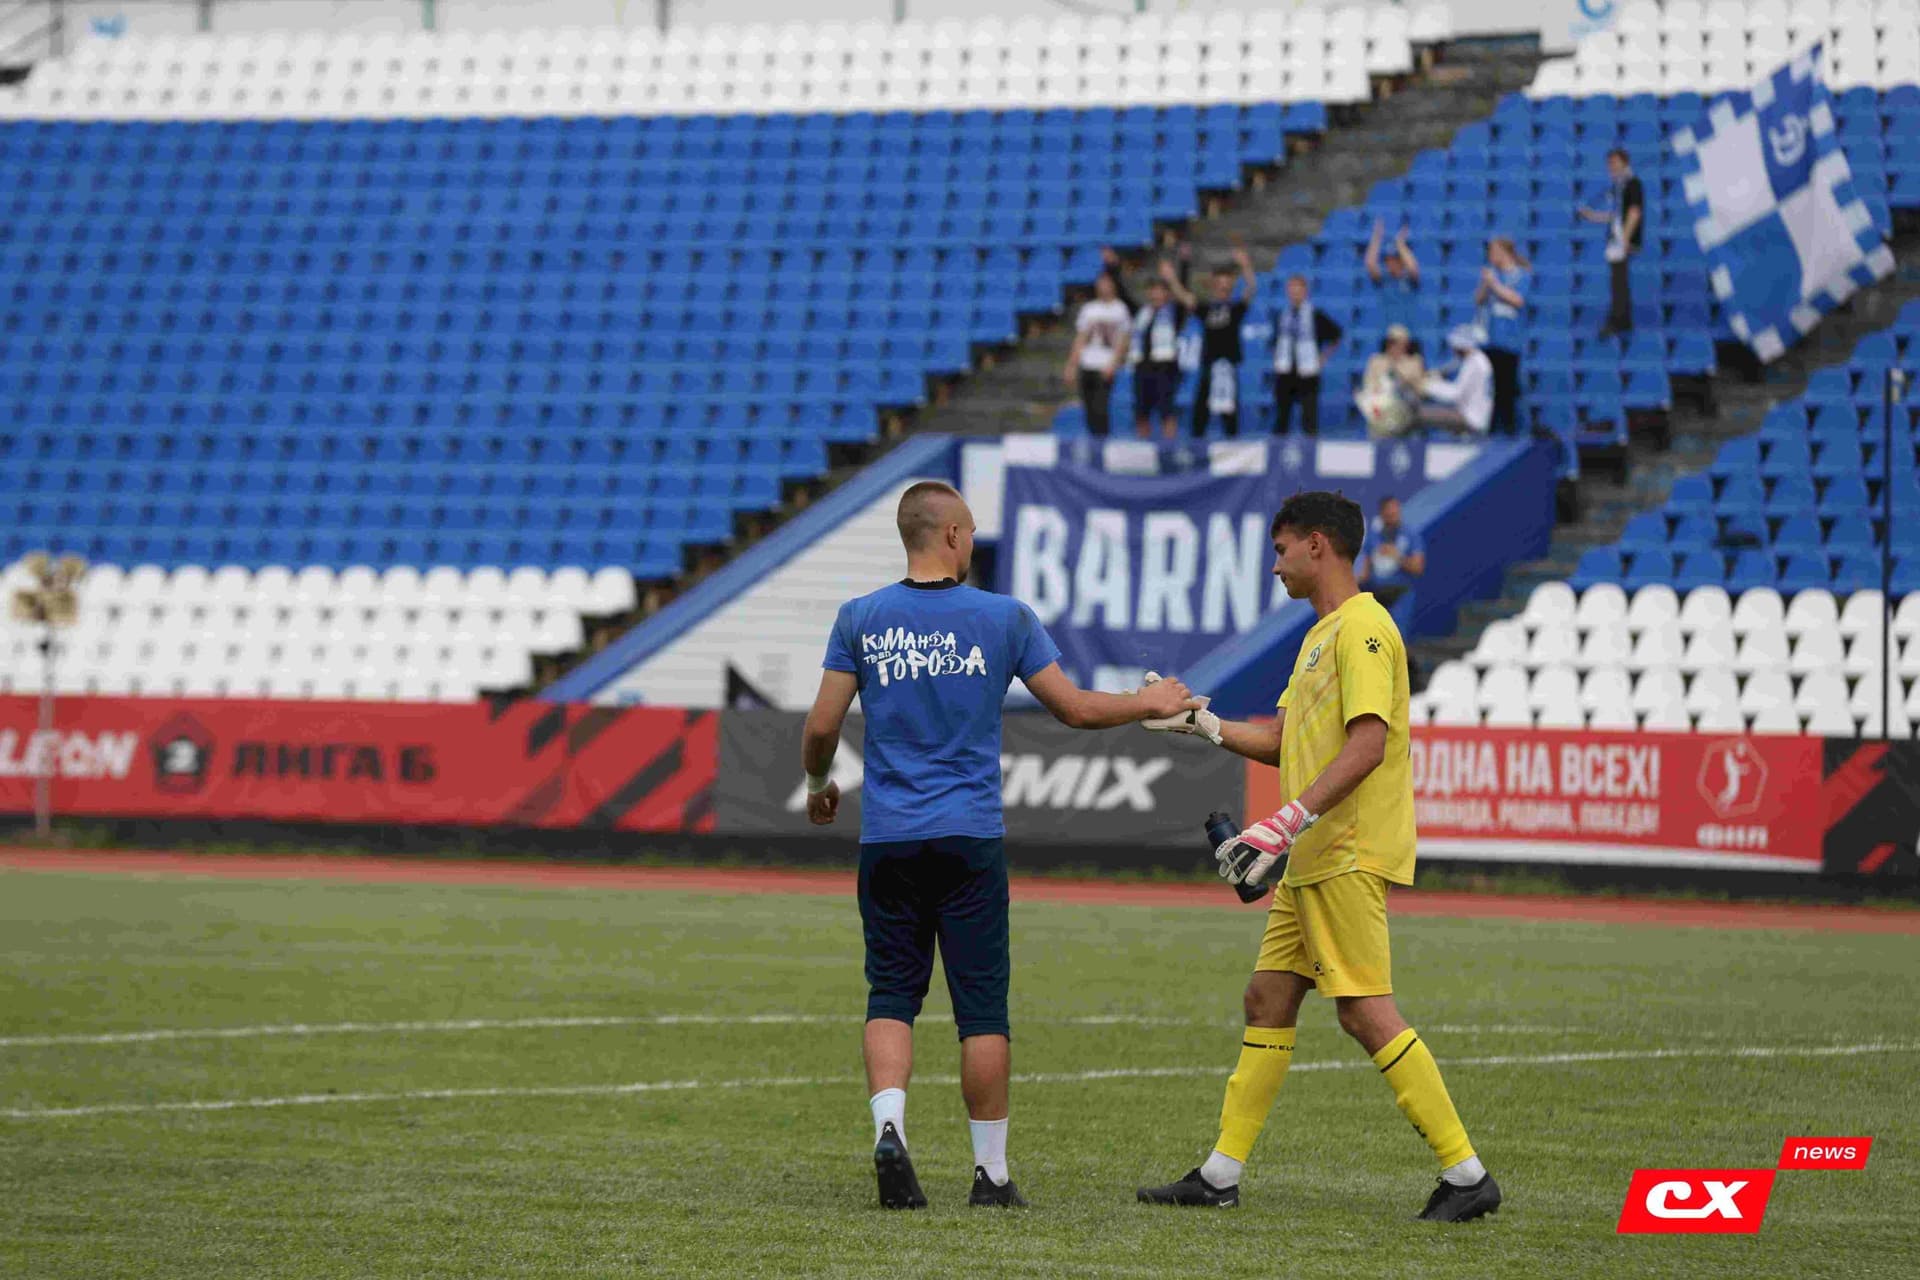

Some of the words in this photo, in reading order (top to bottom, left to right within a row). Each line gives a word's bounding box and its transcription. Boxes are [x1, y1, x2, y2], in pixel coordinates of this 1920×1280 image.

[1012, 504, 1294, 633] BARN
[862, 626, 957, 653] КОМАНДА
[876, 645, 987, 687] ГОРОДА
[1000, 754, 1172, 812] MIX
[1505, 741, 1553, 795] НА
[1558, 743, 1661, 799] ВСЕХ!
